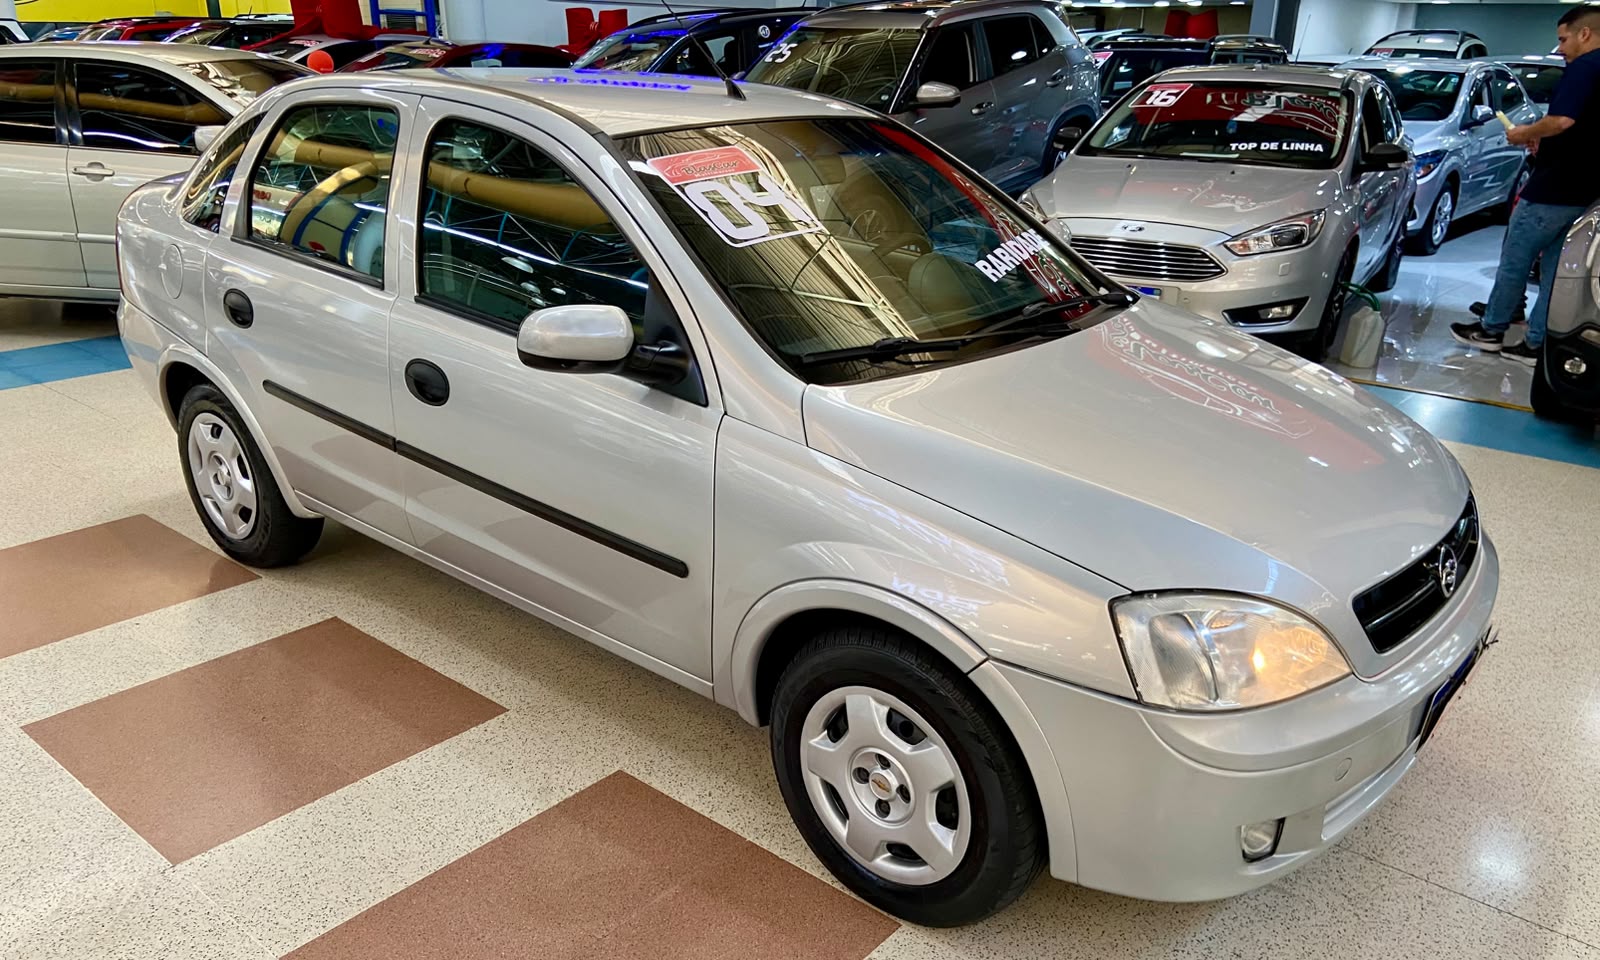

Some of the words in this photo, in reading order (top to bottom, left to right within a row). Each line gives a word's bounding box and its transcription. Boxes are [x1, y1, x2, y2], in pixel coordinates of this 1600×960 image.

[765, 43, 798, 63] 25
[1146, 90, 1180, 105] 16
[1229, 142, 1258, 151] TOP
[1260, 142, 1279, 150] DE
[1282, 142, 1324, 152] LINHA
[682, 160, 738, 175] BlasCar
[685, 175, 816, 240] 04
